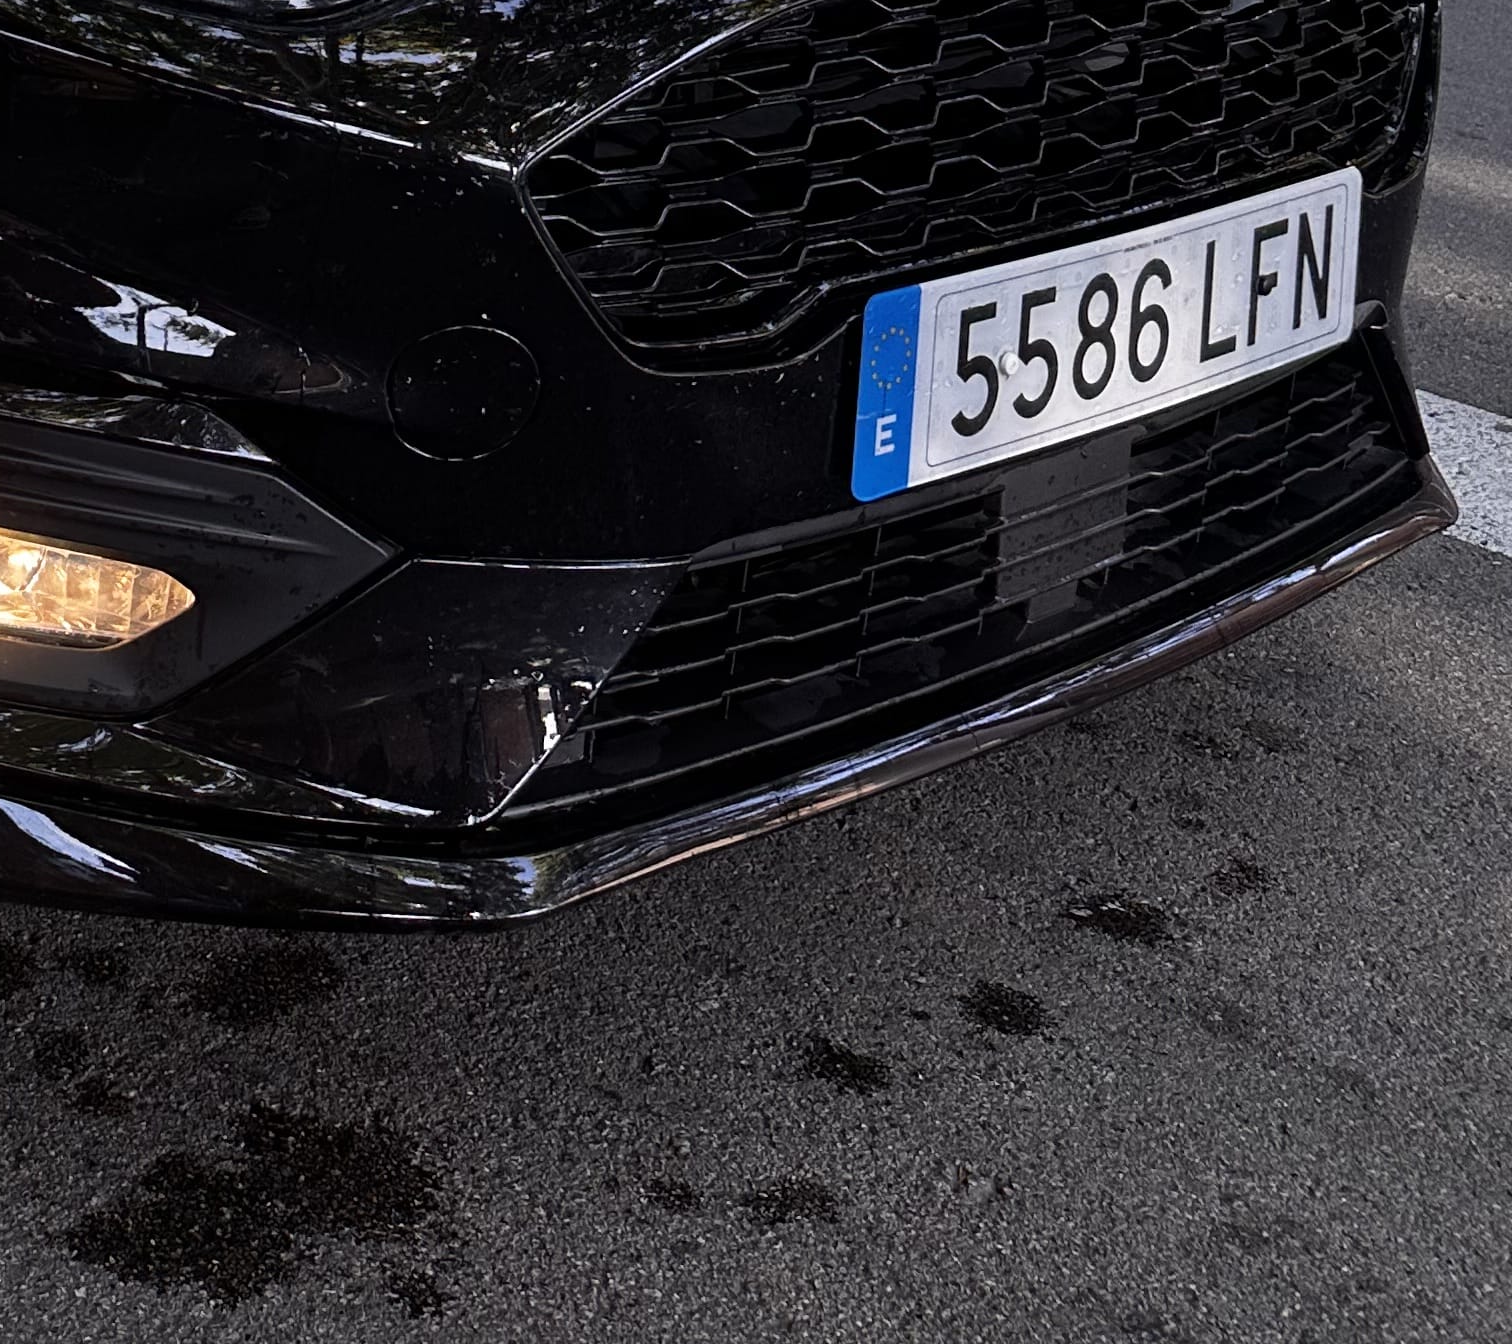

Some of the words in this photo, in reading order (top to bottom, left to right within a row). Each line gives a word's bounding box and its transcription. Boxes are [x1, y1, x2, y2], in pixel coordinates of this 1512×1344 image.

[950, 257, 1173, 437] 5586
[1199, 204, 1334, 364] LFN
[873, 414, 898, 457] E
